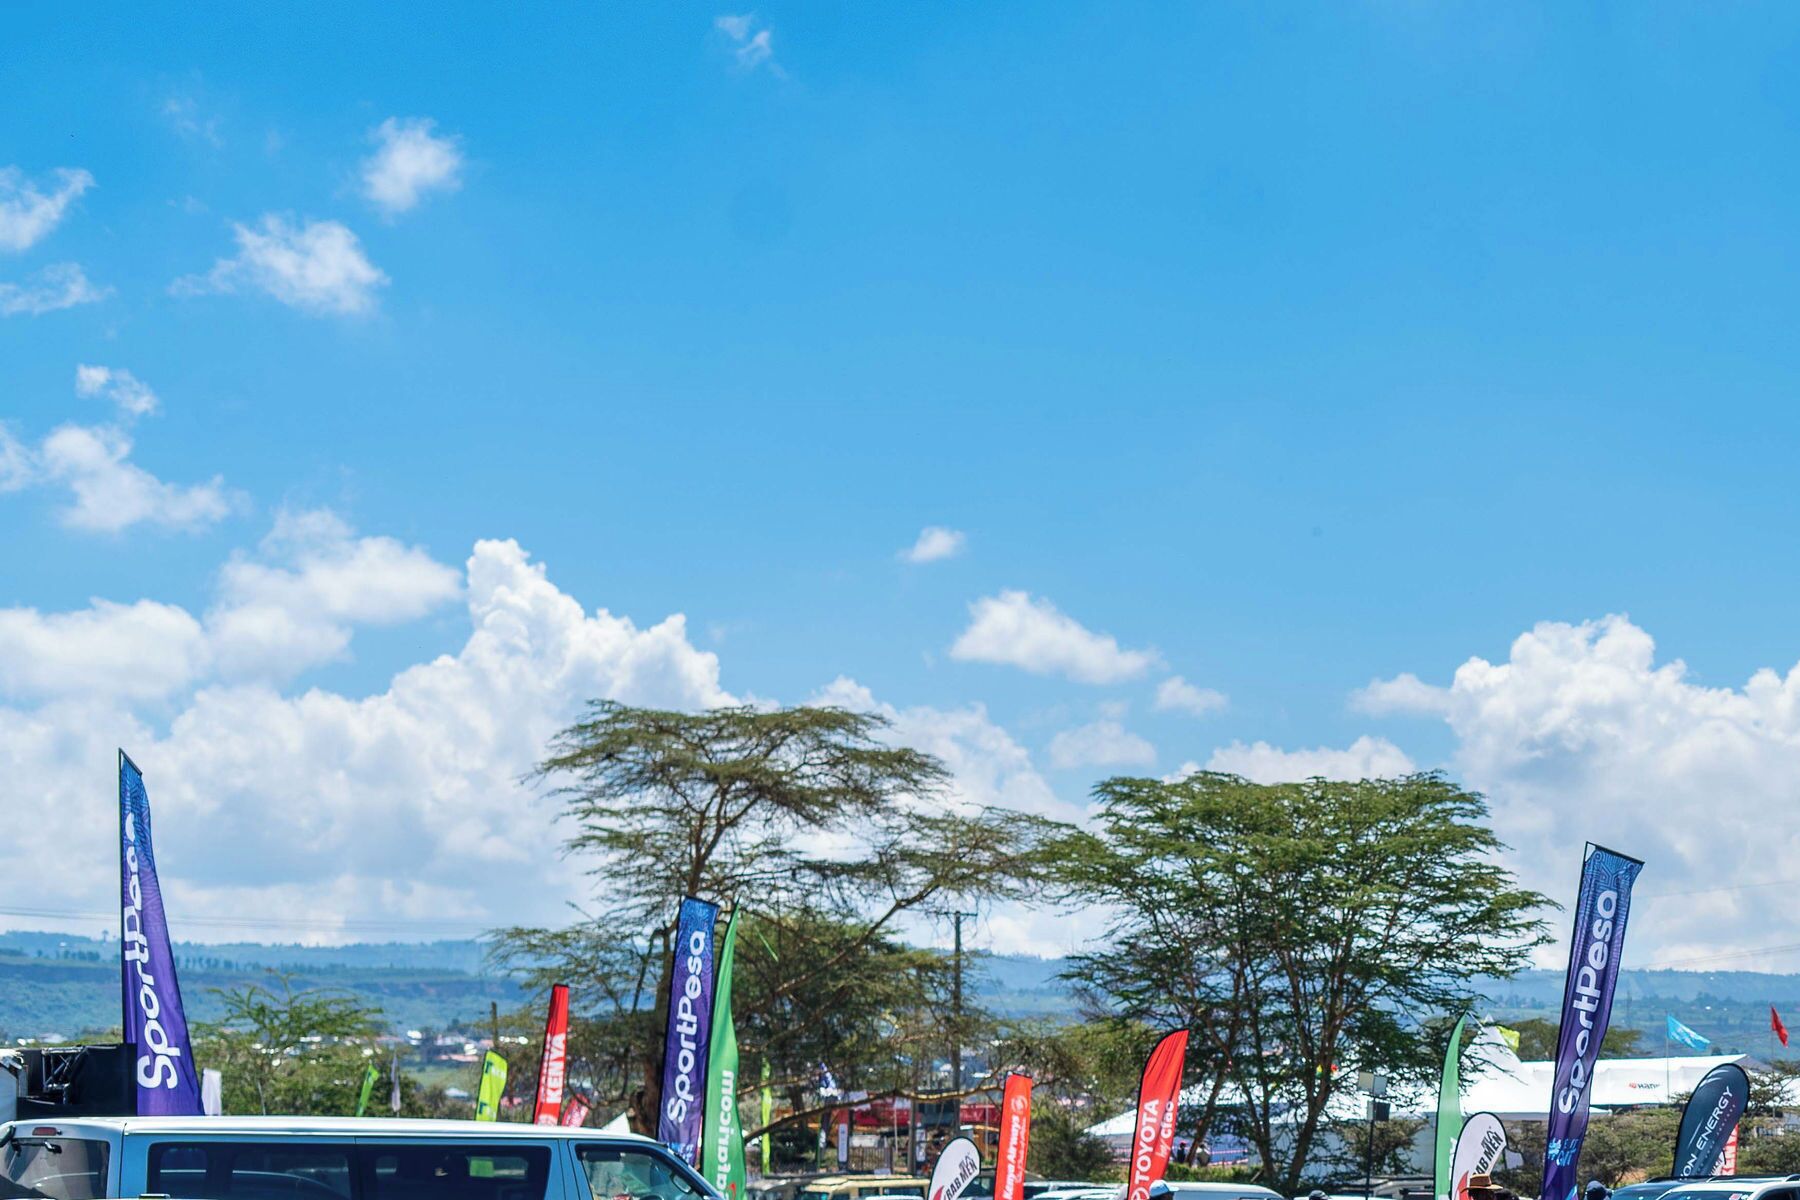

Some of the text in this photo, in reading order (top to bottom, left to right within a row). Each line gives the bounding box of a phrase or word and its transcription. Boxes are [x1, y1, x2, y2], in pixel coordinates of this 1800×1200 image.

[667, 930, 706, 1124] SportPesa
[1559, 890, 1618, 1115] SportPesa
[546, 1033, 567, 1104] KENYA
[1135, 1099, 1159, 1184] TOYOTA
[1696, 1086, 1734, 1150] ENERGY
[1003, 1163, 1016, 1200] Kenya
